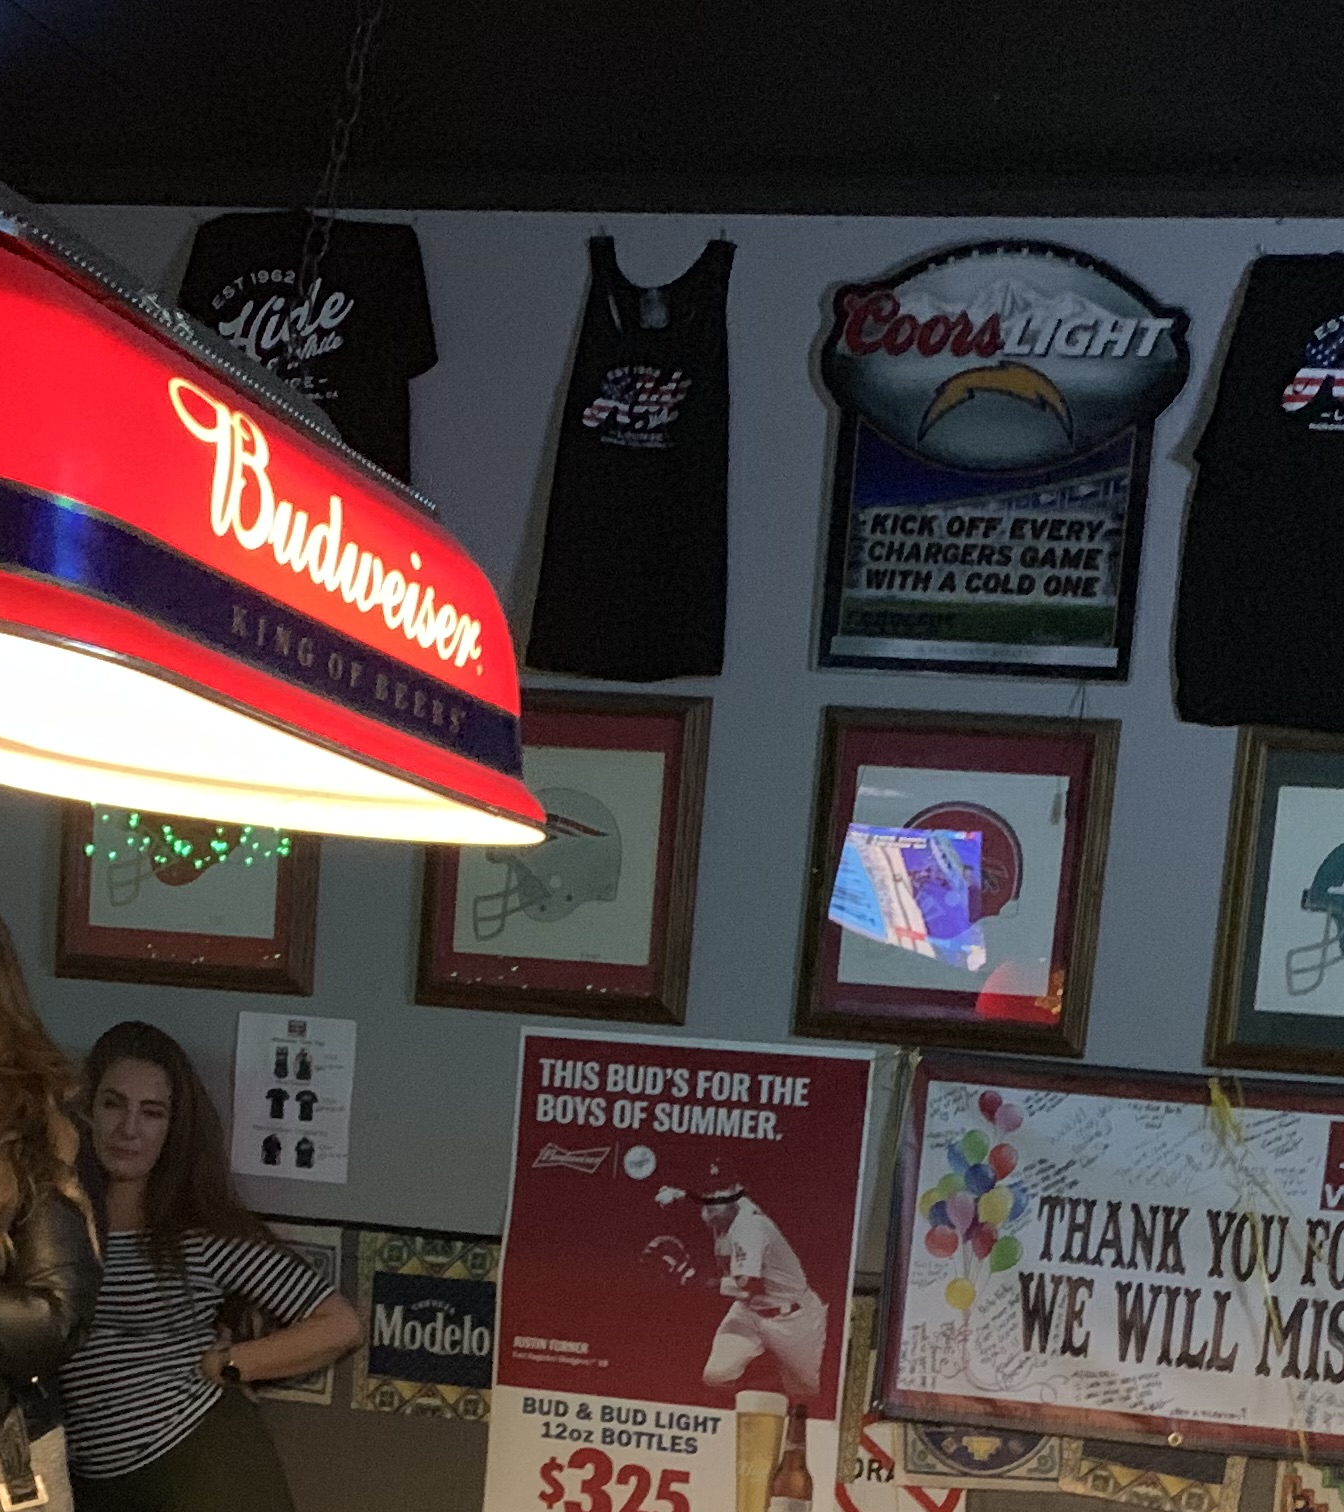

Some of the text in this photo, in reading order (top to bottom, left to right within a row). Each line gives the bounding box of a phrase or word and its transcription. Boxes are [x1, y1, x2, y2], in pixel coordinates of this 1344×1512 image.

[210, 268, 296, 310] EST 1962
[218, 277, 355, 361] Hide
[844, 291, 1176, 358] Coors LIGHT
[869, 513, 1105, 542] KICK OFF EVERY
[866, 540, 1104, 571] CHARGERS GAME
[865, 568, 1101, 598] WITH A COLD ONE
[231, 604, 467, 734] KING OF BEERS
[538, 1058, 811, 1107] THIS BUD'S FOR THE
[536, 1093, 784, 1141] BOYS OF SUMMER.
[1037, 1195, 1190, 1275] THANK
[1206, 1208, 1290, 1284] YOU
[372, 1303, 491, 1357] Modelo
[1017, 1272, 1095, 1360] WE
[1115, 1281, 1238, 1375] WILL
[522, 1397, 722, 1436] BUD & BUD LIGHT
[541, 1421, 699, 1455] 12oz BOTTLES
